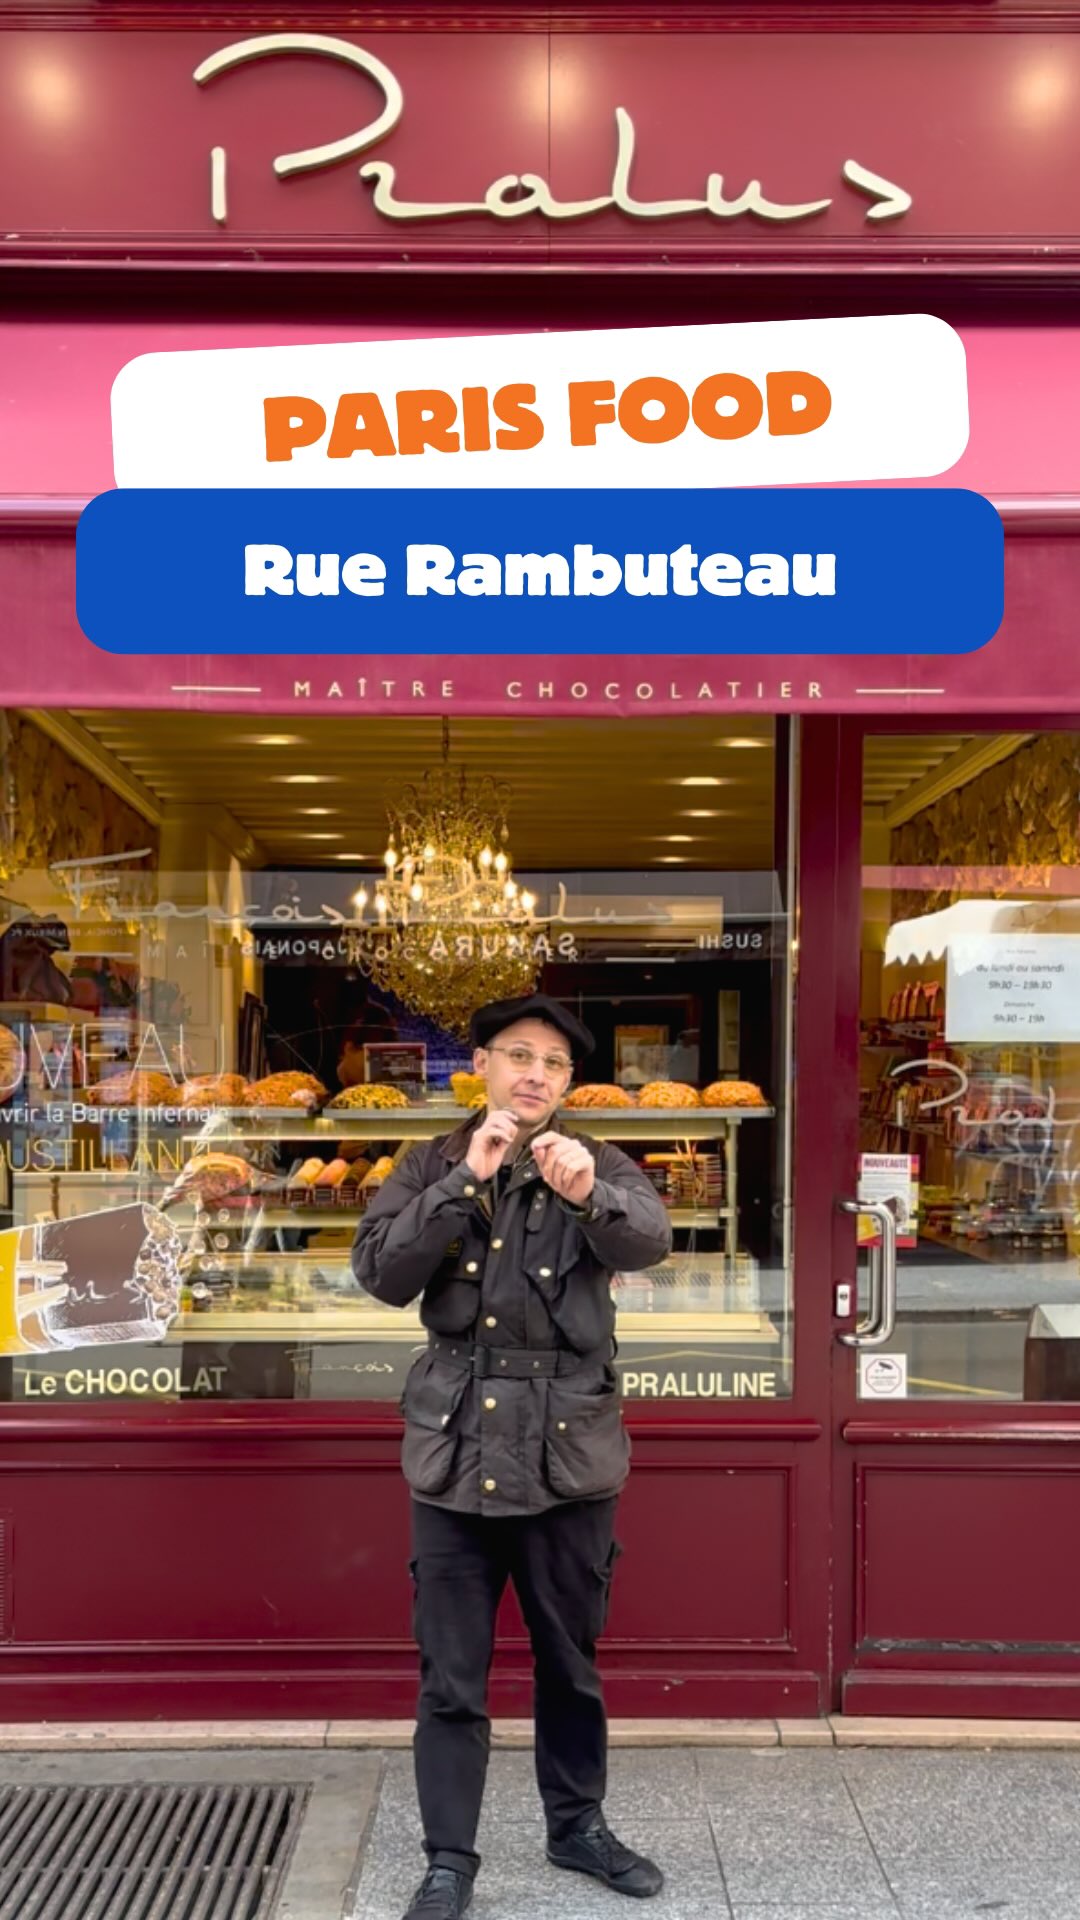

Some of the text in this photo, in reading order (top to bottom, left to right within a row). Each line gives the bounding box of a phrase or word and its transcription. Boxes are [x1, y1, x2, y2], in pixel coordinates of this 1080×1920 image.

[193, 33, 913, 224] Pralus
[293, 677, 824, 700] MAÎTRE CHOCOLATIER
[46, 1104, 65, 1123] la
[72, 1103, 130, 1123] Barre
[138, 1103, 229, 1123] Infernale
[24, 1366, 229, 1396] Le CHOCOLAT
[622, 1372, 776, 1398] PRALULINE
